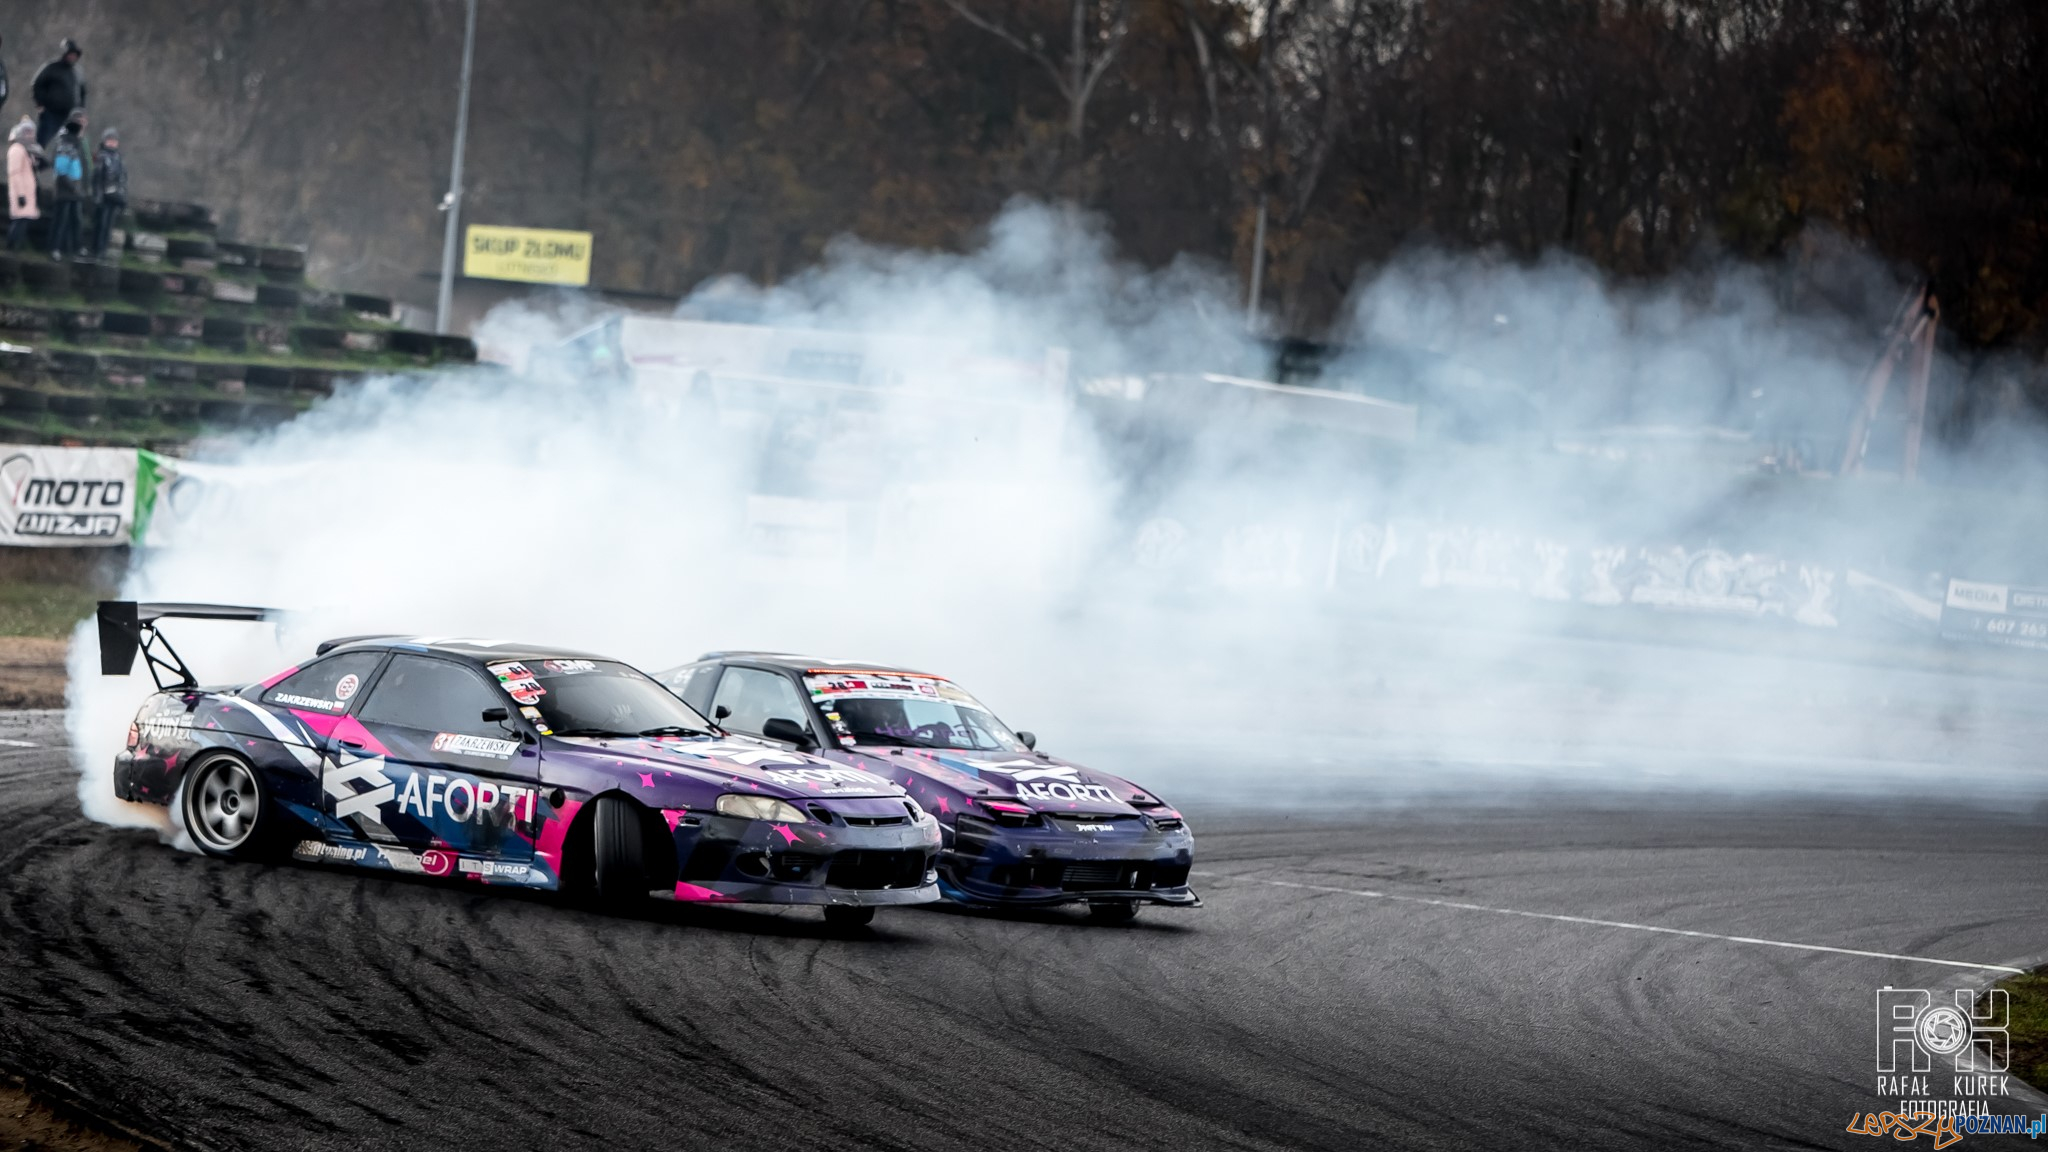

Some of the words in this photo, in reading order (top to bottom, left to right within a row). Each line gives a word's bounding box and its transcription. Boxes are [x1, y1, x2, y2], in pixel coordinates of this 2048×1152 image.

[24, 479, 124, 506] MOTO
[17, 513, 119, 536] WIZJA
[1953, 587, 2001, 605] MEDIA
[1986, 618, 2015, 635] 607
[274, 692, 334, 711] ZAKRZEWSKI
[454, 736, 512, 752] ZAKRZEWSKI
[764, 768, 878, 785] AFORTI
[397, 772, 535, 832] AFORTI
[1016, 782, 1124, 804] AFORTI
[494, 865, 528, 875] WRAP
